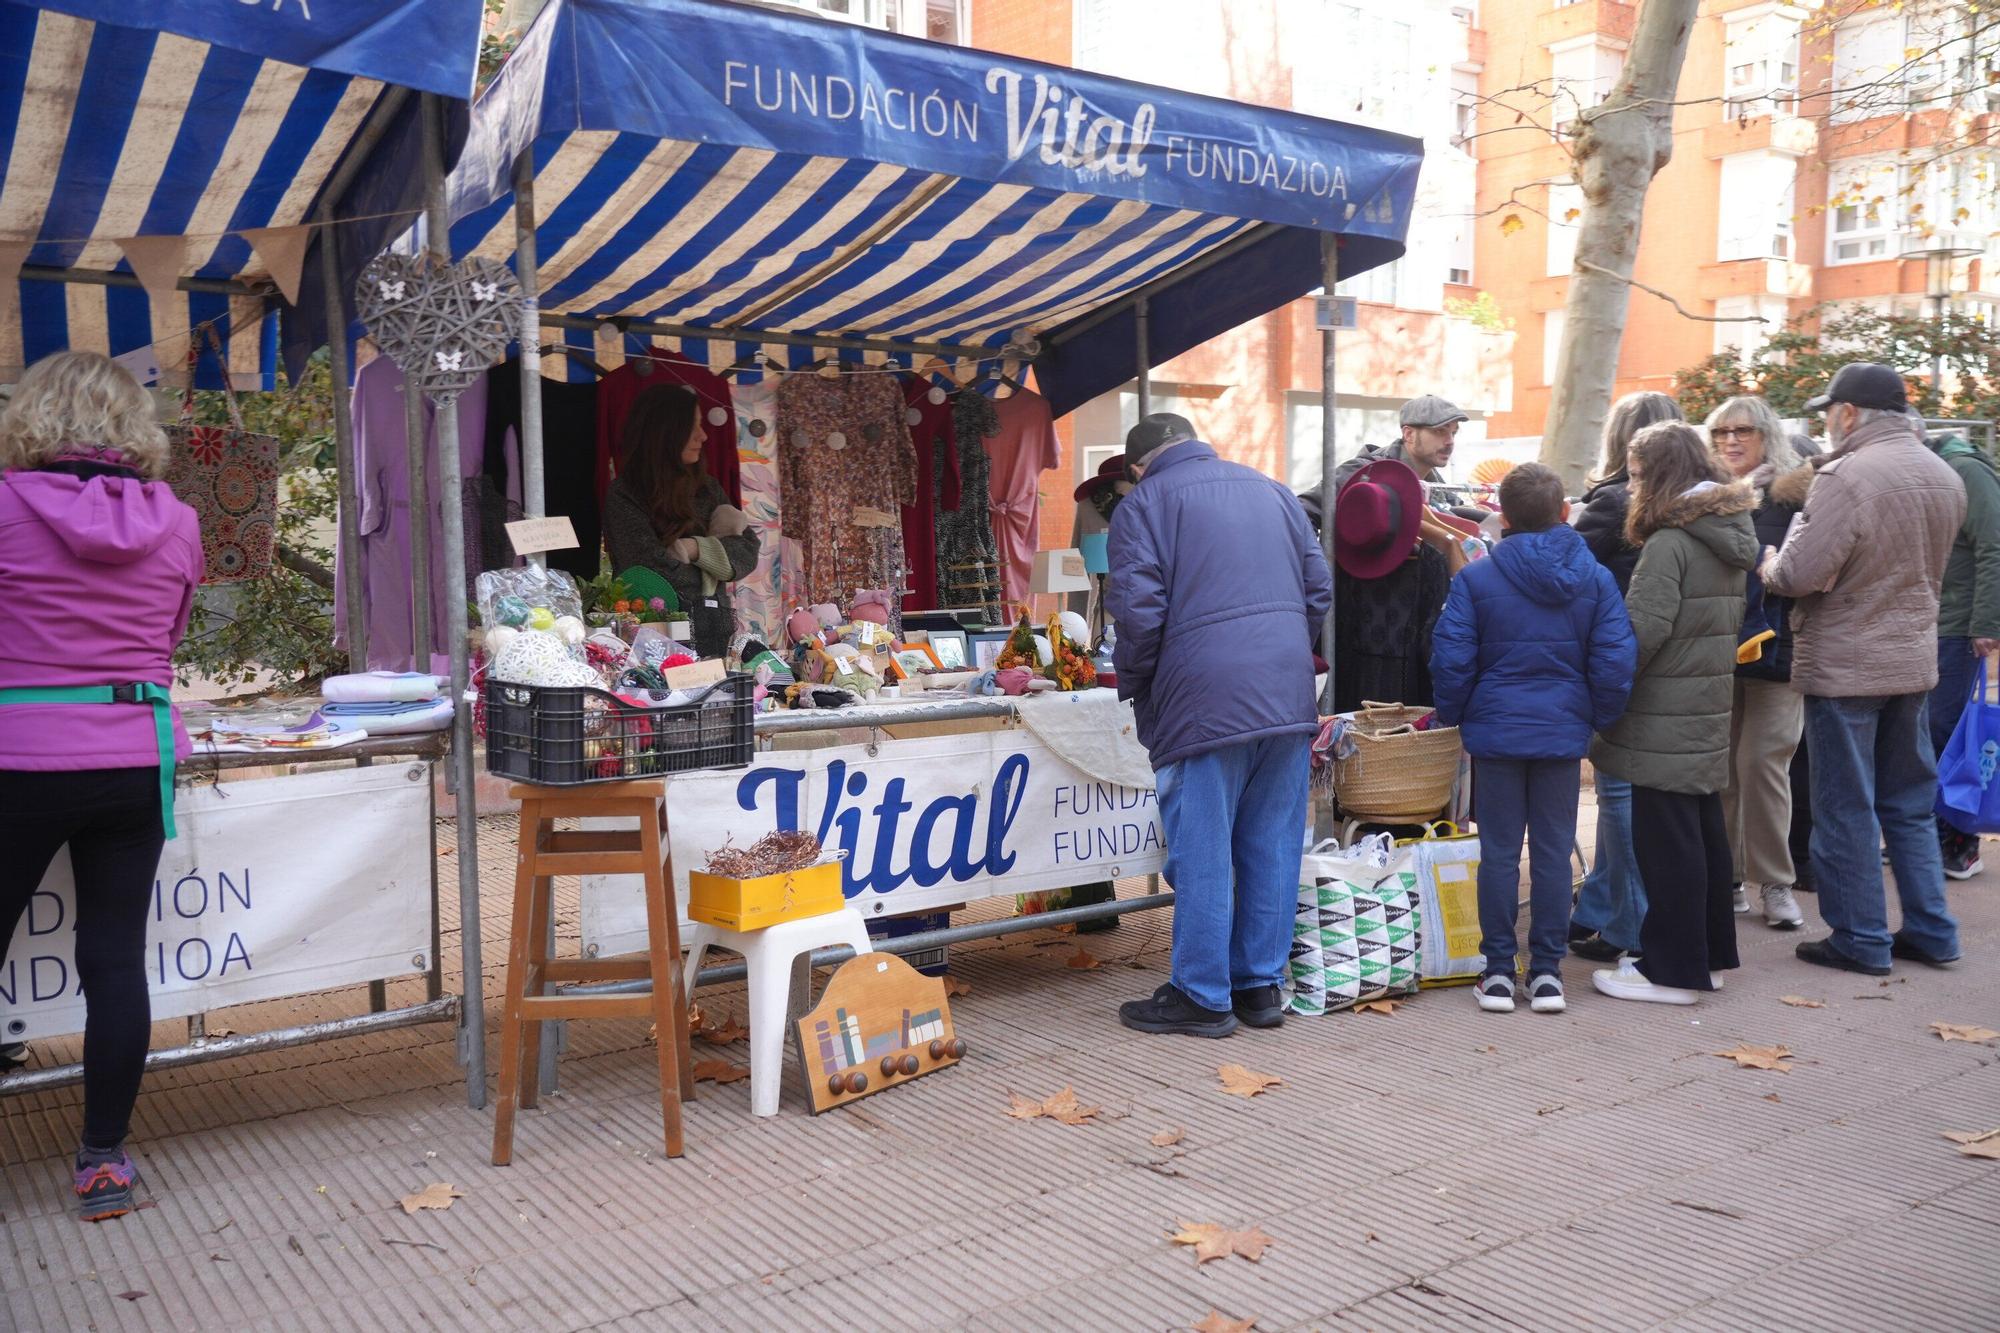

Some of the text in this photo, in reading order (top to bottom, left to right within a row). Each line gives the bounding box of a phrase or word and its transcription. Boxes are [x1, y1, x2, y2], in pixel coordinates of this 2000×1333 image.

[725, 60, 1349, 201] FUNDACIÓN Vital FUNDAZIOA
[736, 753, 1030, 900] Vital
